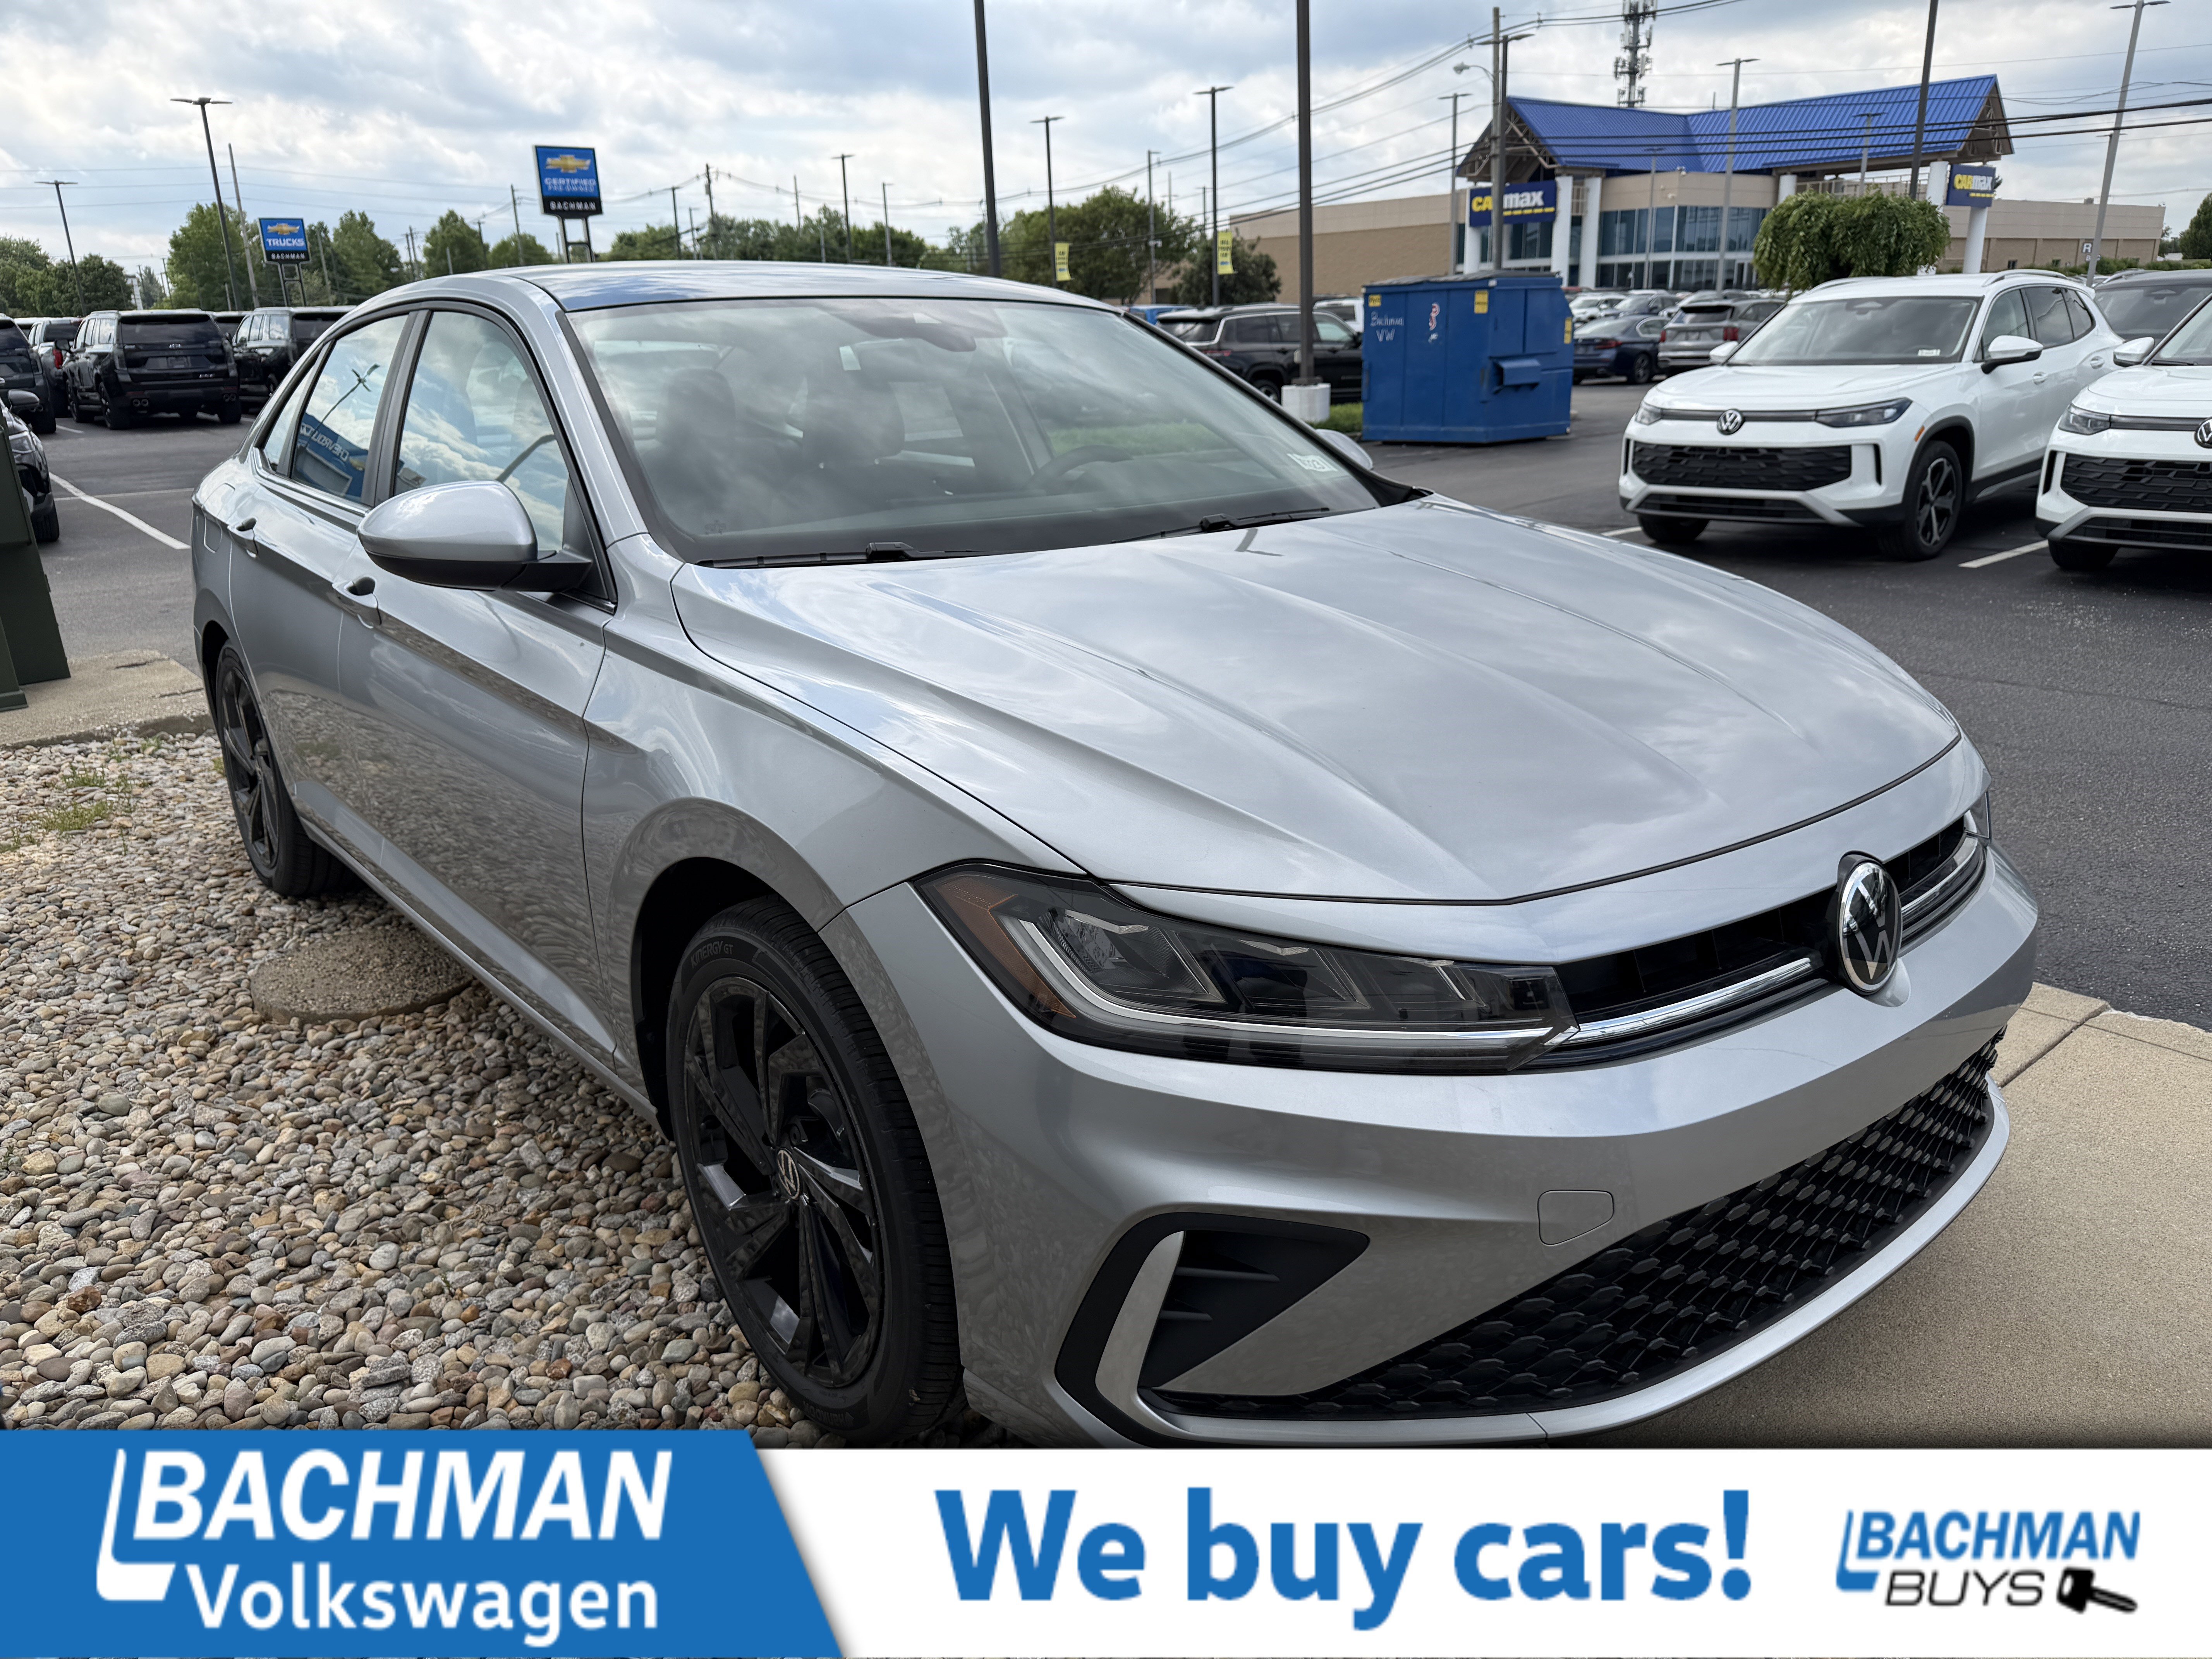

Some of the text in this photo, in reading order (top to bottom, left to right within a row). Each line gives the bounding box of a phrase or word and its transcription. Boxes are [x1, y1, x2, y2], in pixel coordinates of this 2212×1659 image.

[550, 201, 596, 211] BACHMAN
[1472, 191, 1544, 212] CAmax
[266, 238, 305, 247] TRUCKS
[1376, 328, 1396, 342] VW
[724, 944, 733, 954] GT
